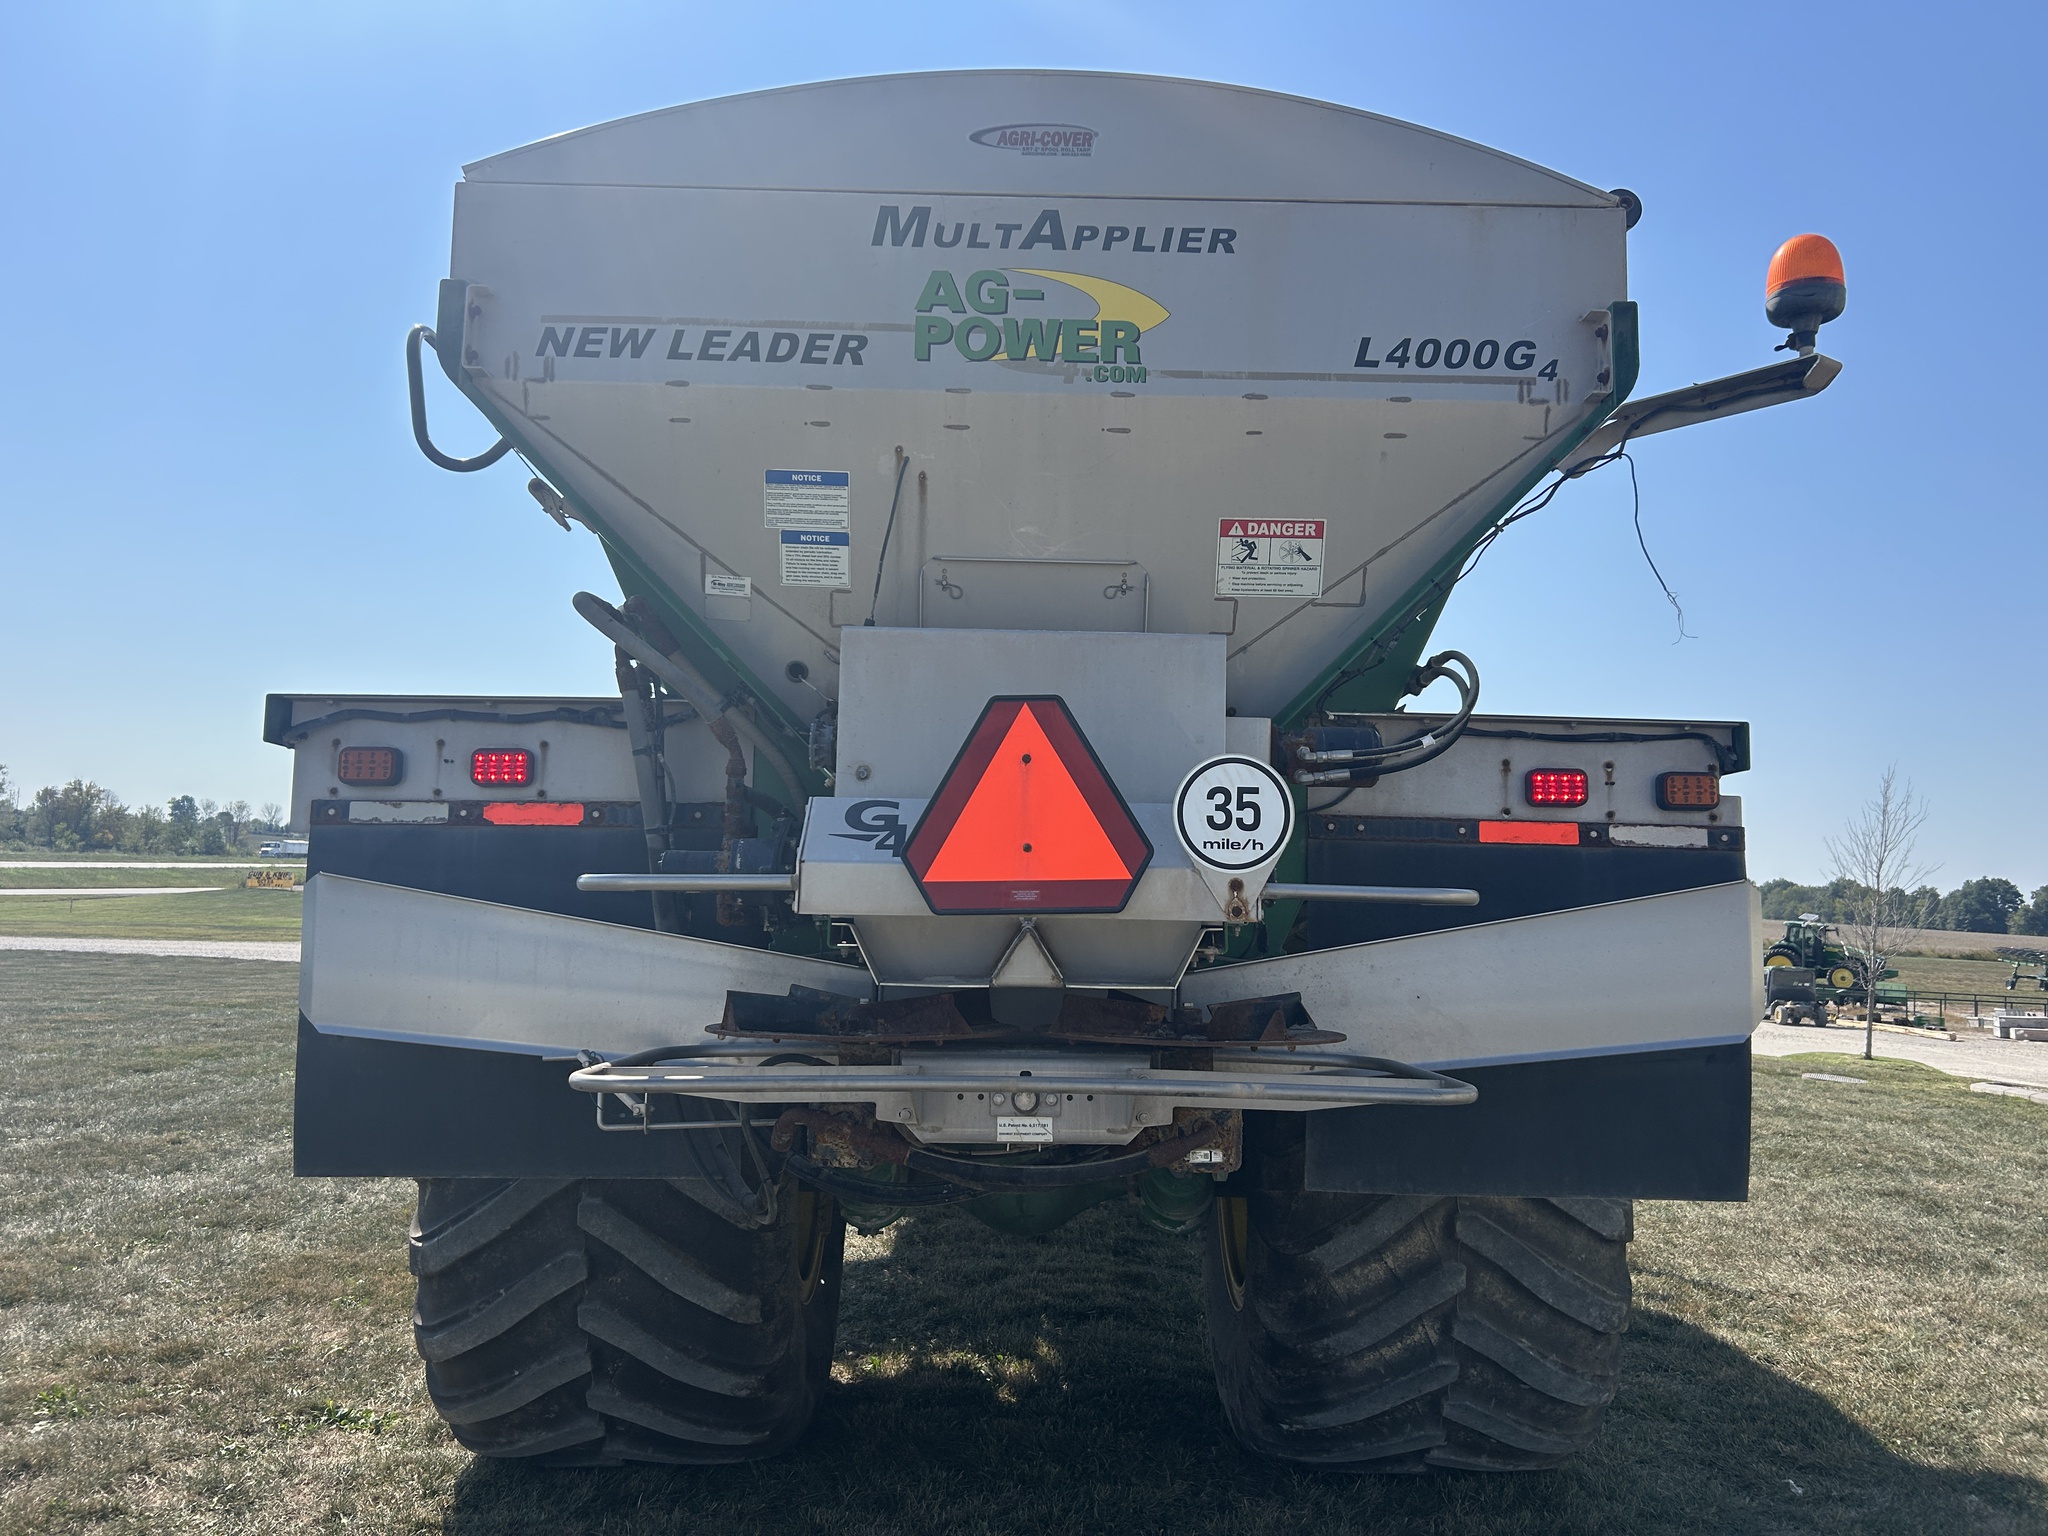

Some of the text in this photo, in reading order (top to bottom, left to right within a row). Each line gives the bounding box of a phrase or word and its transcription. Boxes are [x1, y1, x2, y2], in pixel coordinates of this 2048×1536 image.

[996, 130, 1094, 148] AGRI-COVER
[914, 270, 1044, 315] AG-
[535, 326, 868, 366] NEW LEADER
[914, 316, 1142, 365] POWER
[1085, 365, 1147, 384] .COM
[1247, 522, 1316, 536] DANGER
[1206, 786, 1261, 832] 35
[1203, 838, 1264, 850] mile/h
